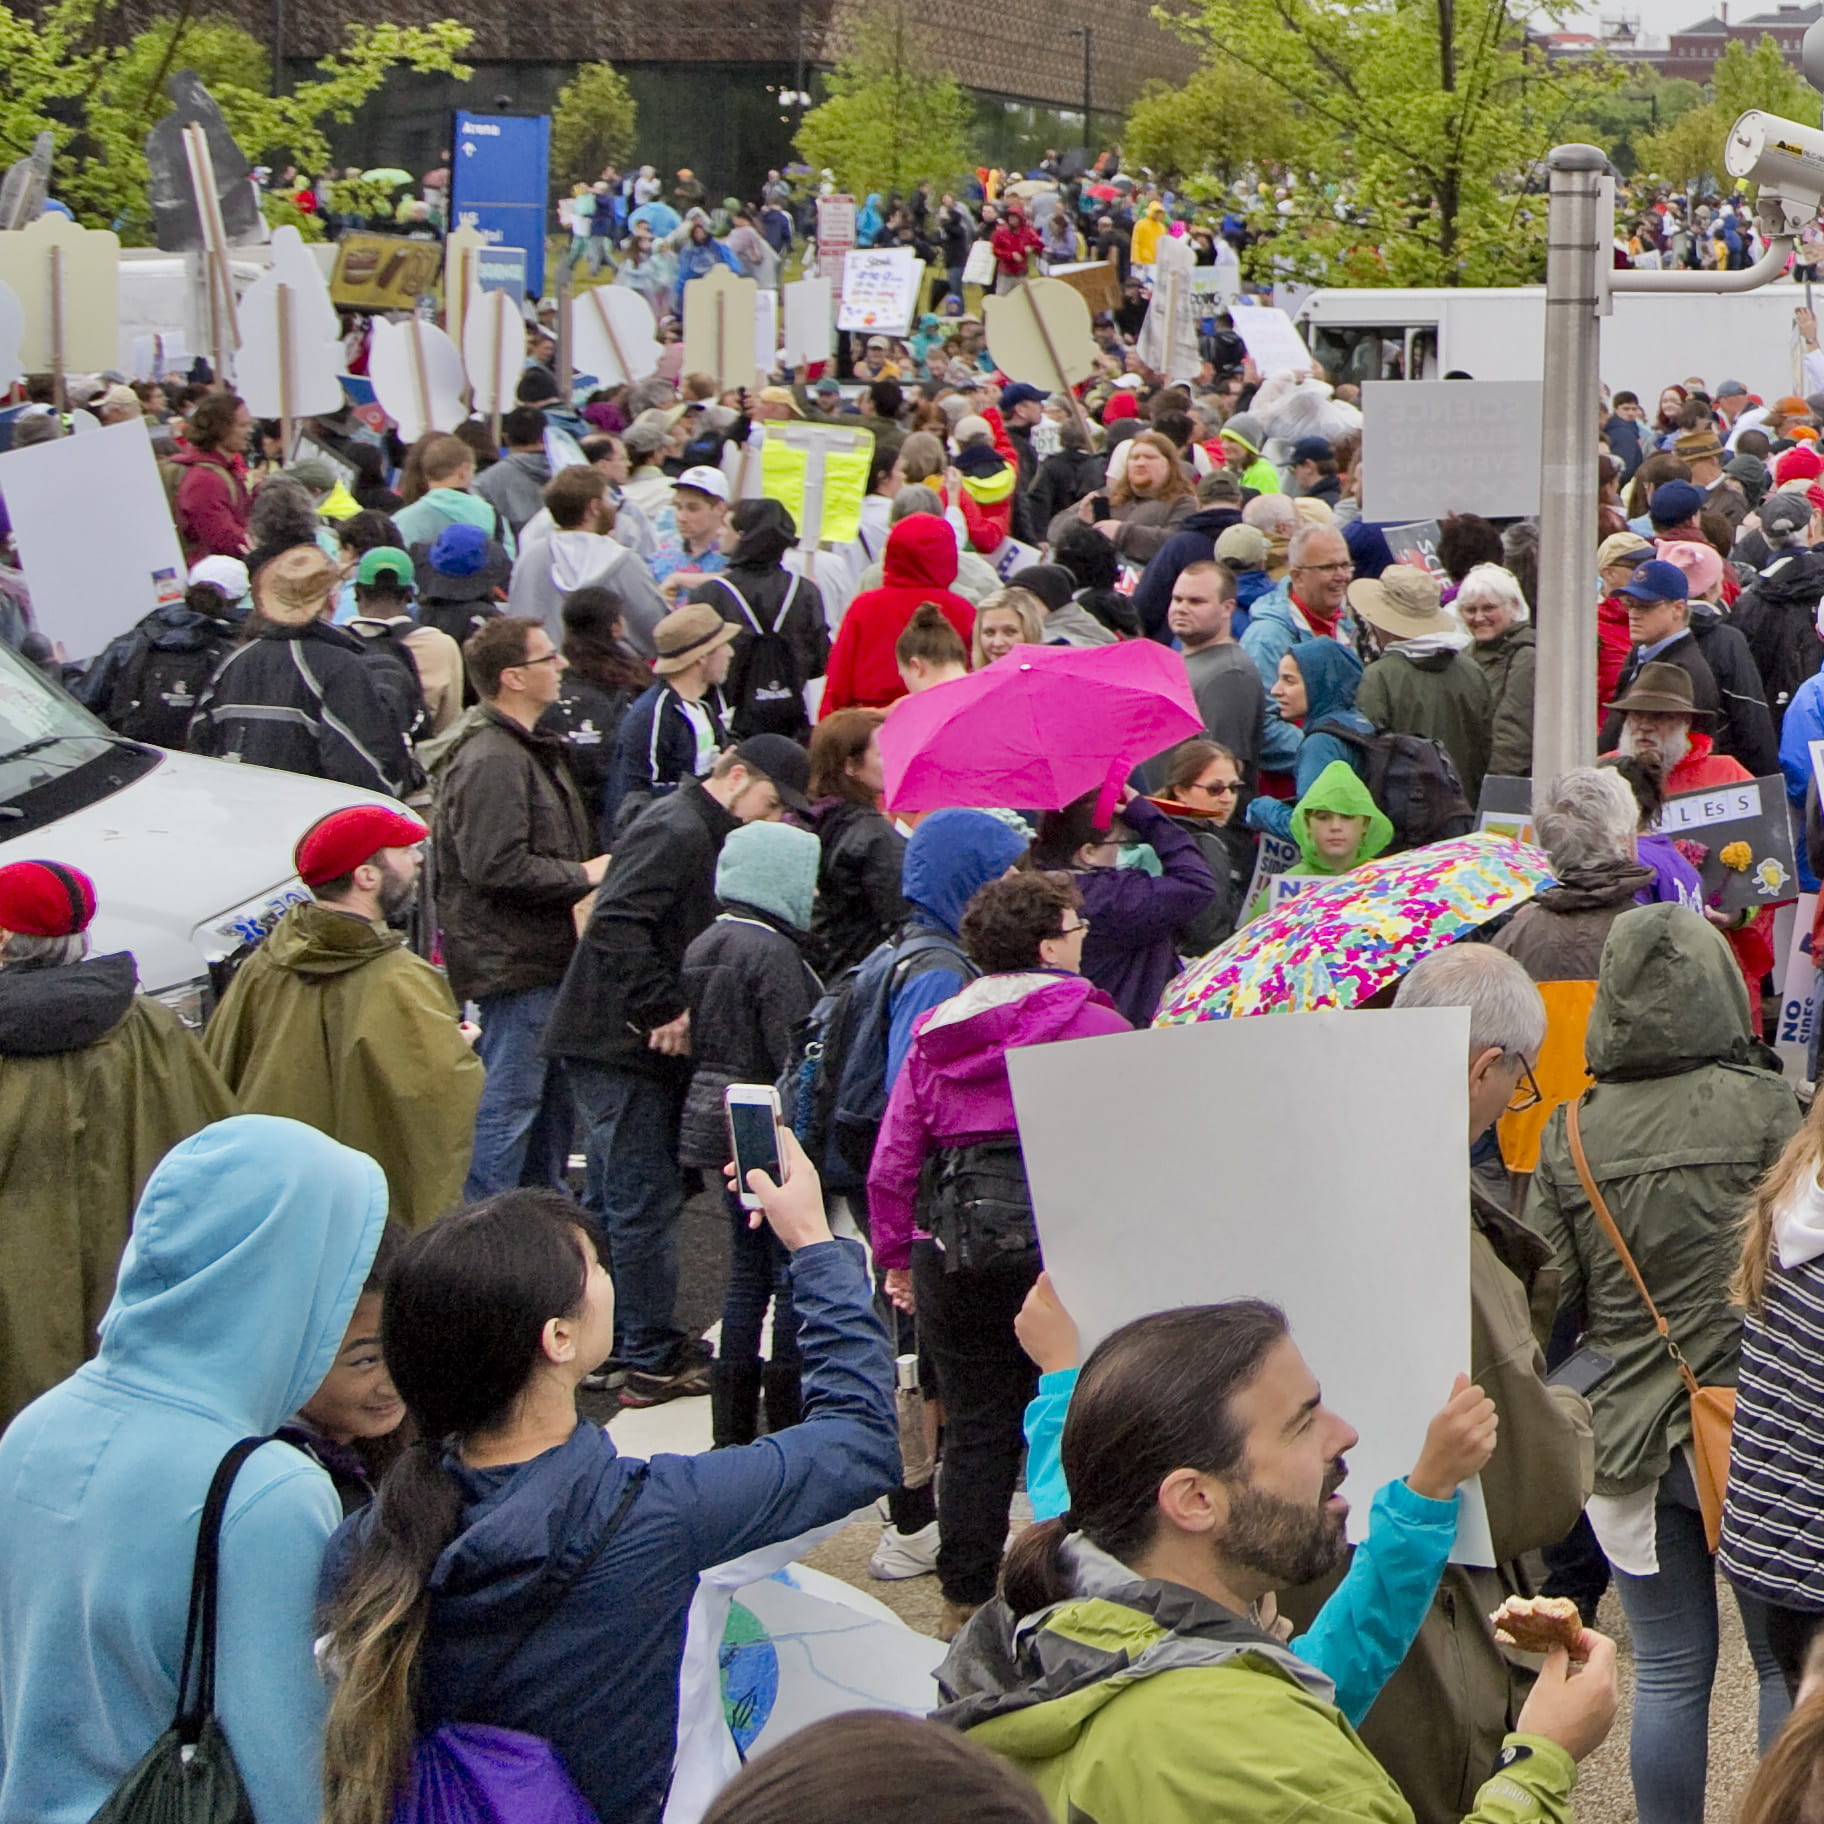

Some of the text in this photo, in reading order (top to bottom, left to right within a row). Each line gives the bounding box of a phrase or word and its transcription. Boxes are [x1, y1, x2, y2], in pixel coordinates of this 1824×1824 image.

[1416, 538, 1455, 590] SCIE
[1263, 838, 1297, 860] NO
[1781, 999, 1802, 1043] NO
